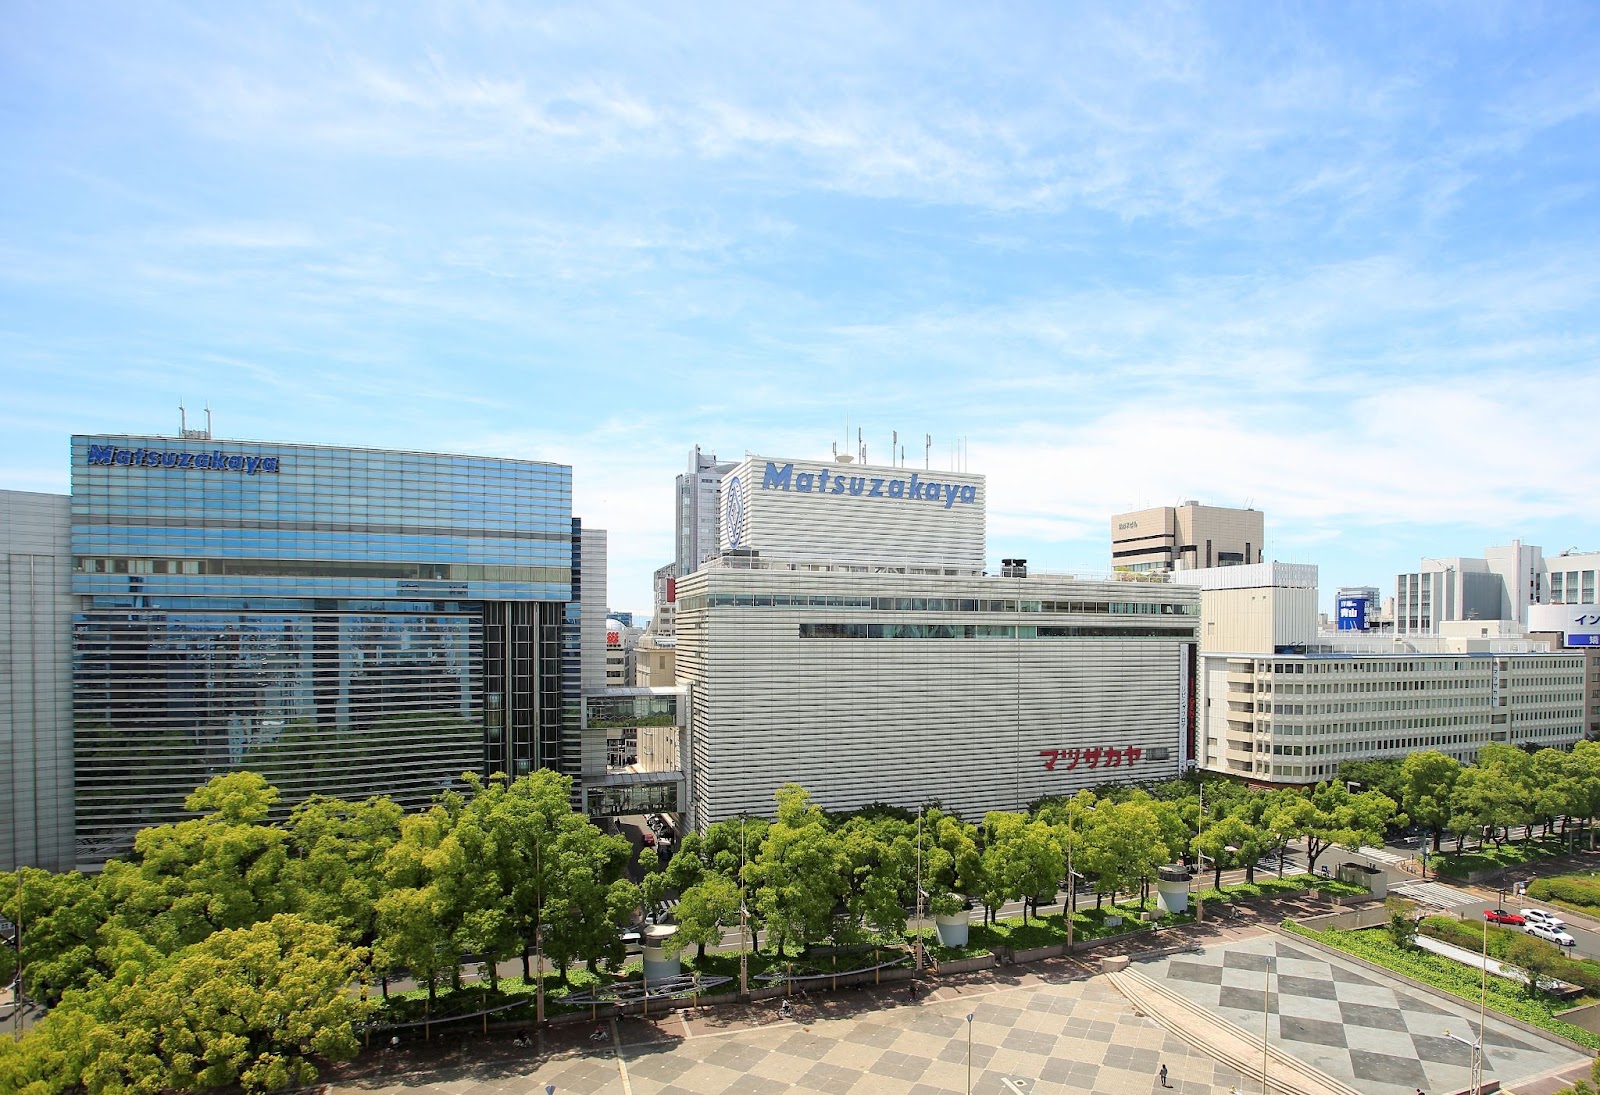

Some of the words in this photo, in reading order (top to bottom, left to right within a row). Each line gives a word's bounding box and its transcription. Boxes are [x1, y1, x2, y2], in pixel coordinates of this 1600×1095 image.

[88, 444, 279, 475] Matsuzakaya
[762, 462, 977, 509] Matsuzakaya
[1040, 745, 1142, 771] マツザカヤ
